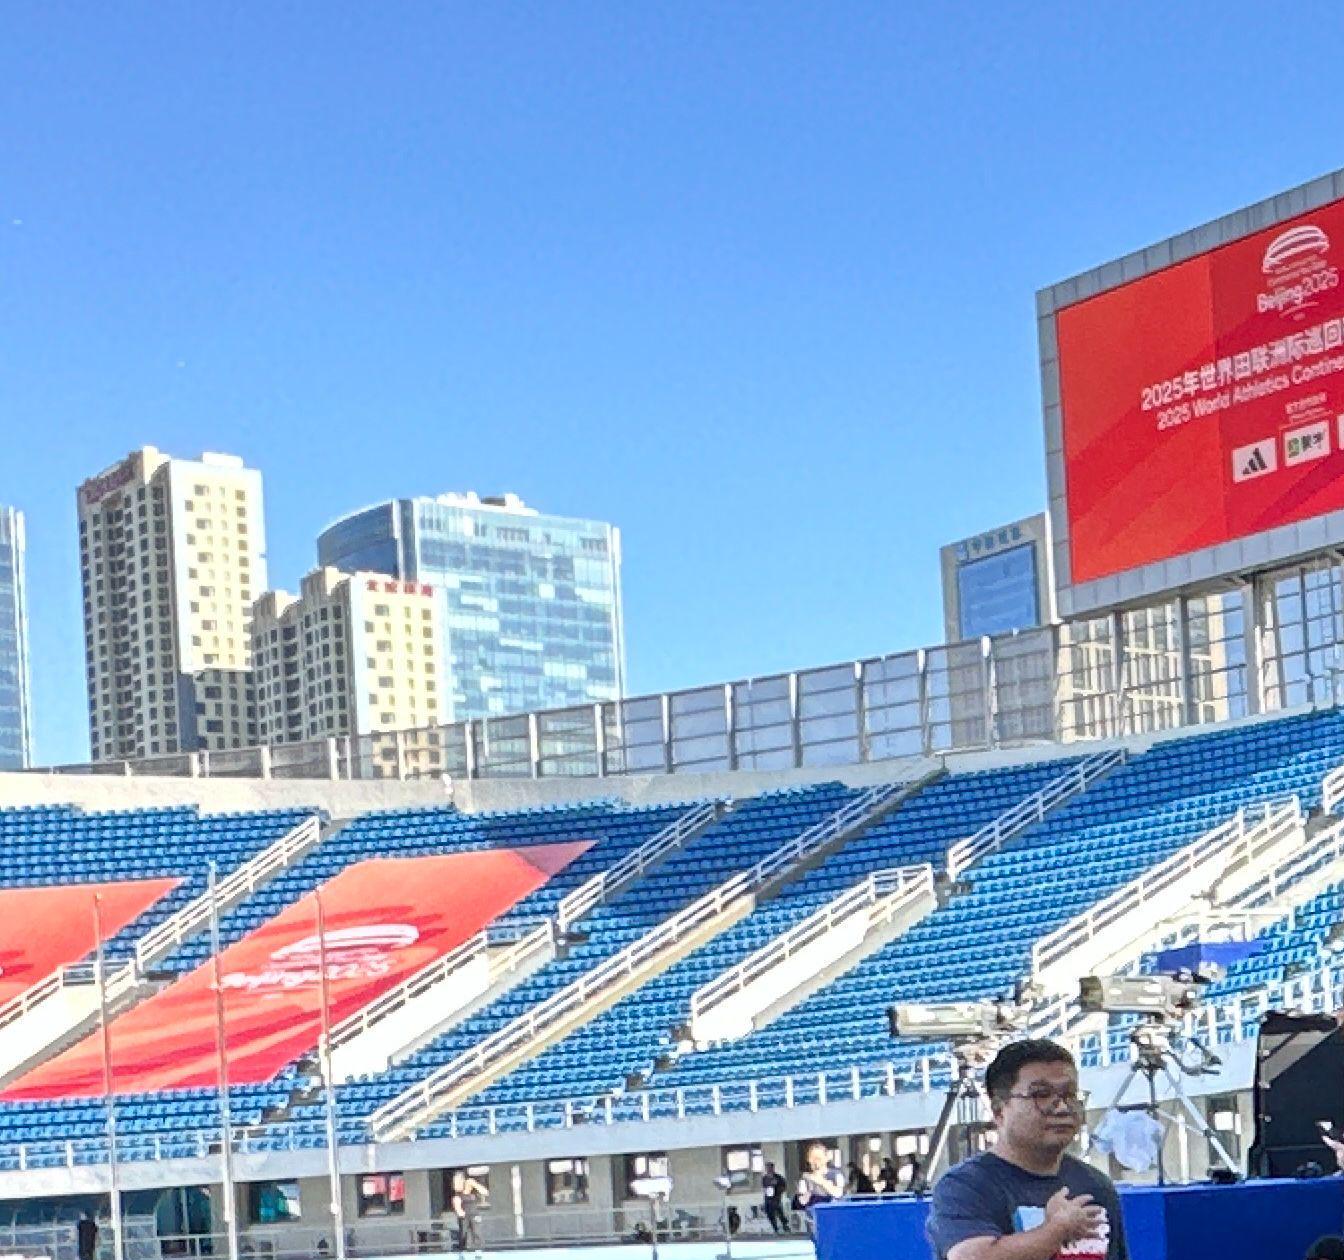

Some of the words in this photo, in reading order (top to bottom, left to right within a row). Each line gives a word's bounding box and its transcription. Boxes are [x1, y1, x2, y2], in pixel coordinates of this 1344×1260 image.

[1157, 403, 1191, 430] 2025
[1193, 391, 1230, 417] World
[1233, 374, 1290, 404] Athletics
